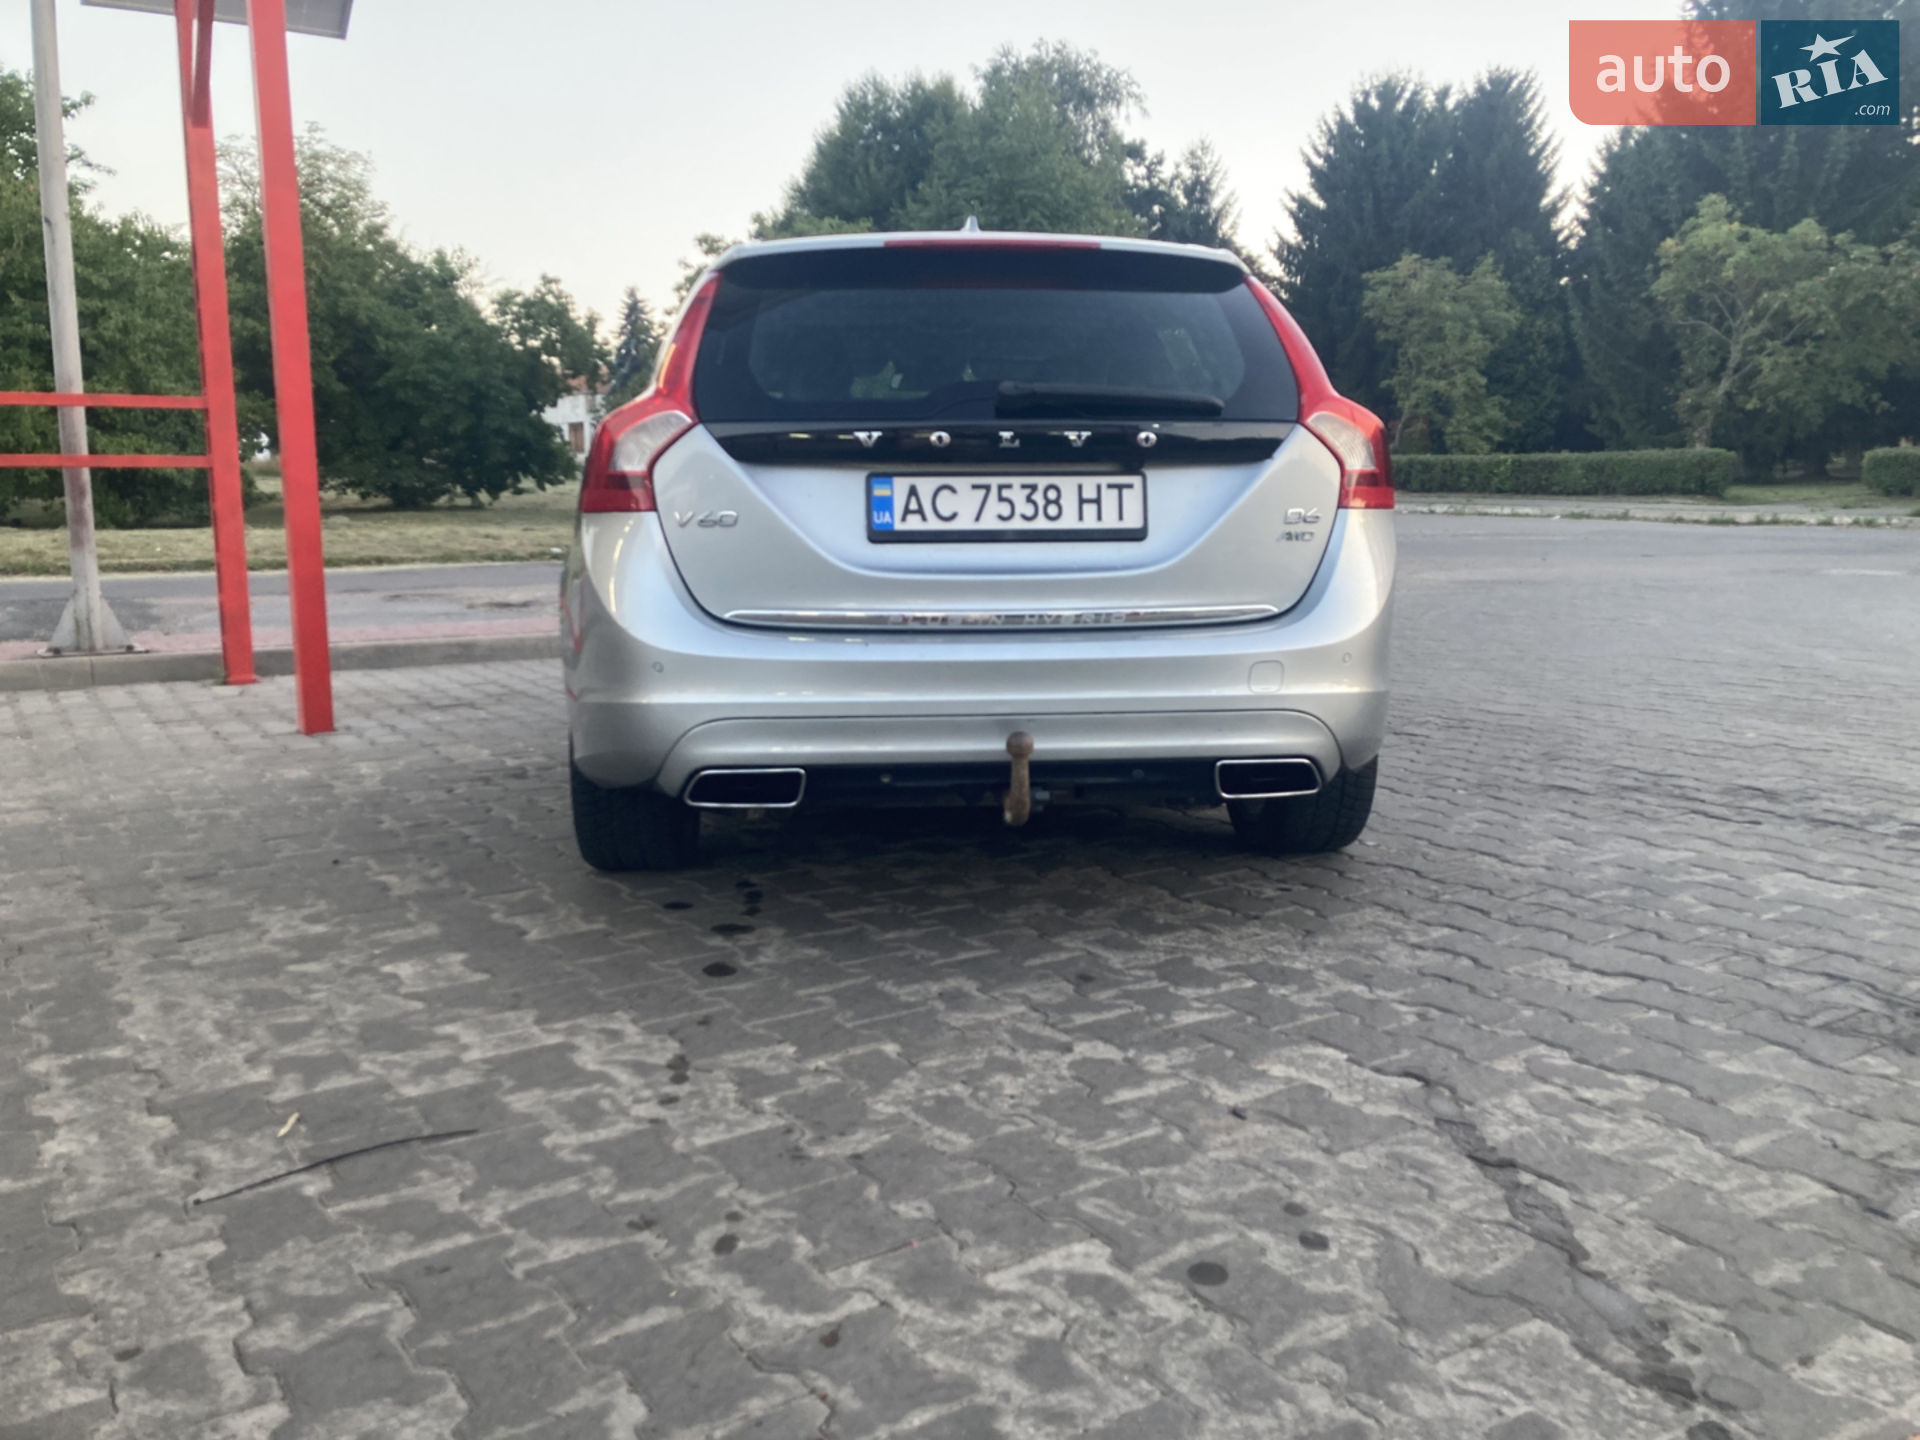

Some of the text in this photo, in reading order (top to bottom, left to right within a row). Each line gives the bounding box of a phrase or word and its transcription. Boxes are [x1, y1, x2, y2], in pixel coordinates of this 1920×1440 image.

[853, 431, 1157, 447] VOLVO
[900, 482, 1135, 522] AC 7538 HT
[873, 510, 892, 524] UA
[1283, 507, 1323, 525] D6
